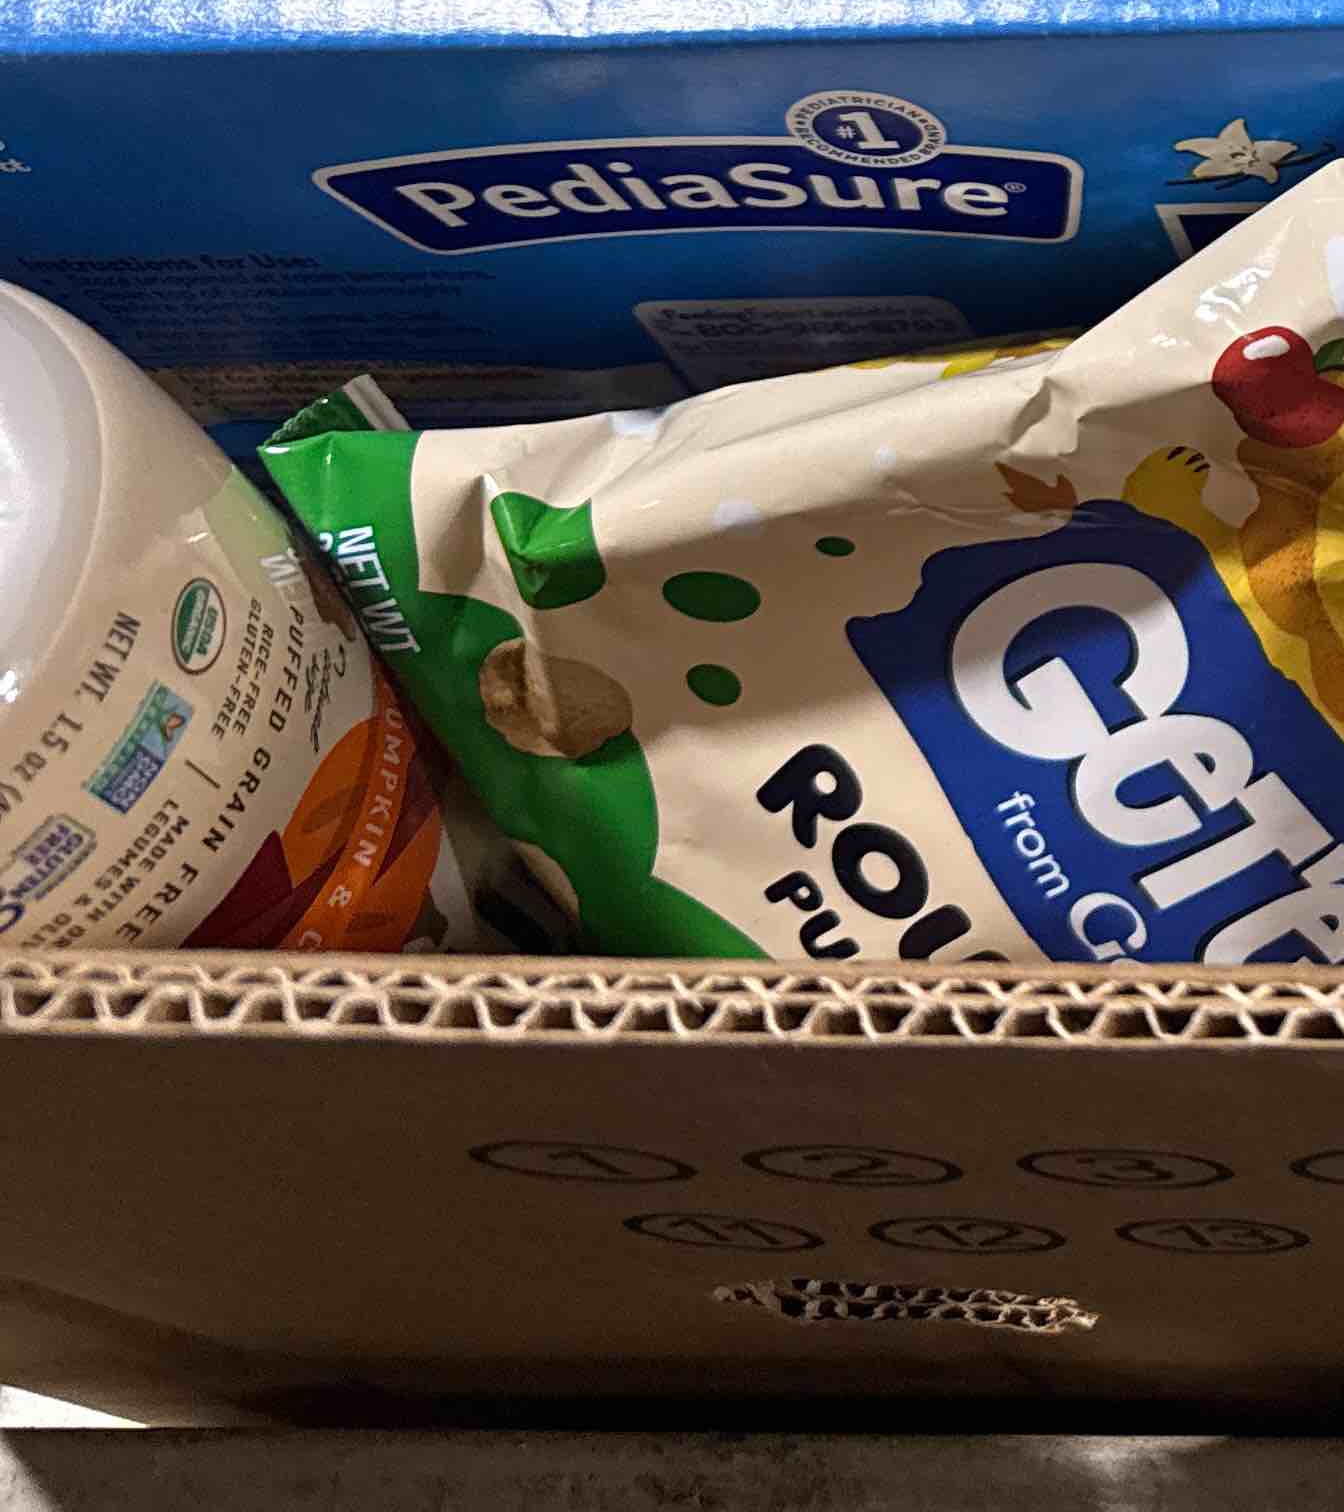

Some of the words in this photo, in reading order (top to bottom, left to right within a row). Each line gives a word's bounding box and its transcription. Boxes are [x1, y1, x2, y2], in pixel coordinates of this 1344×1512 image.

[337, 525, 390, 591] NET
[104, 611, 142, 668] NET
[360, 597, 422, 655] WT
[232, 622, 275, 738] RICE-FREE
[268, 605, 306, 734] PUFFED
[202, 746, 272, 853] GRAIN
[95, 798, 180, 890] LEGUMES
[997, 790, 1070, 901] from
[115, 863, 199, 943] FREE
[665, 1215, 782, 1245] 11
[917, 1218, 1023, 1250] 12
[1157, 1219, 1272, 1253] 13
